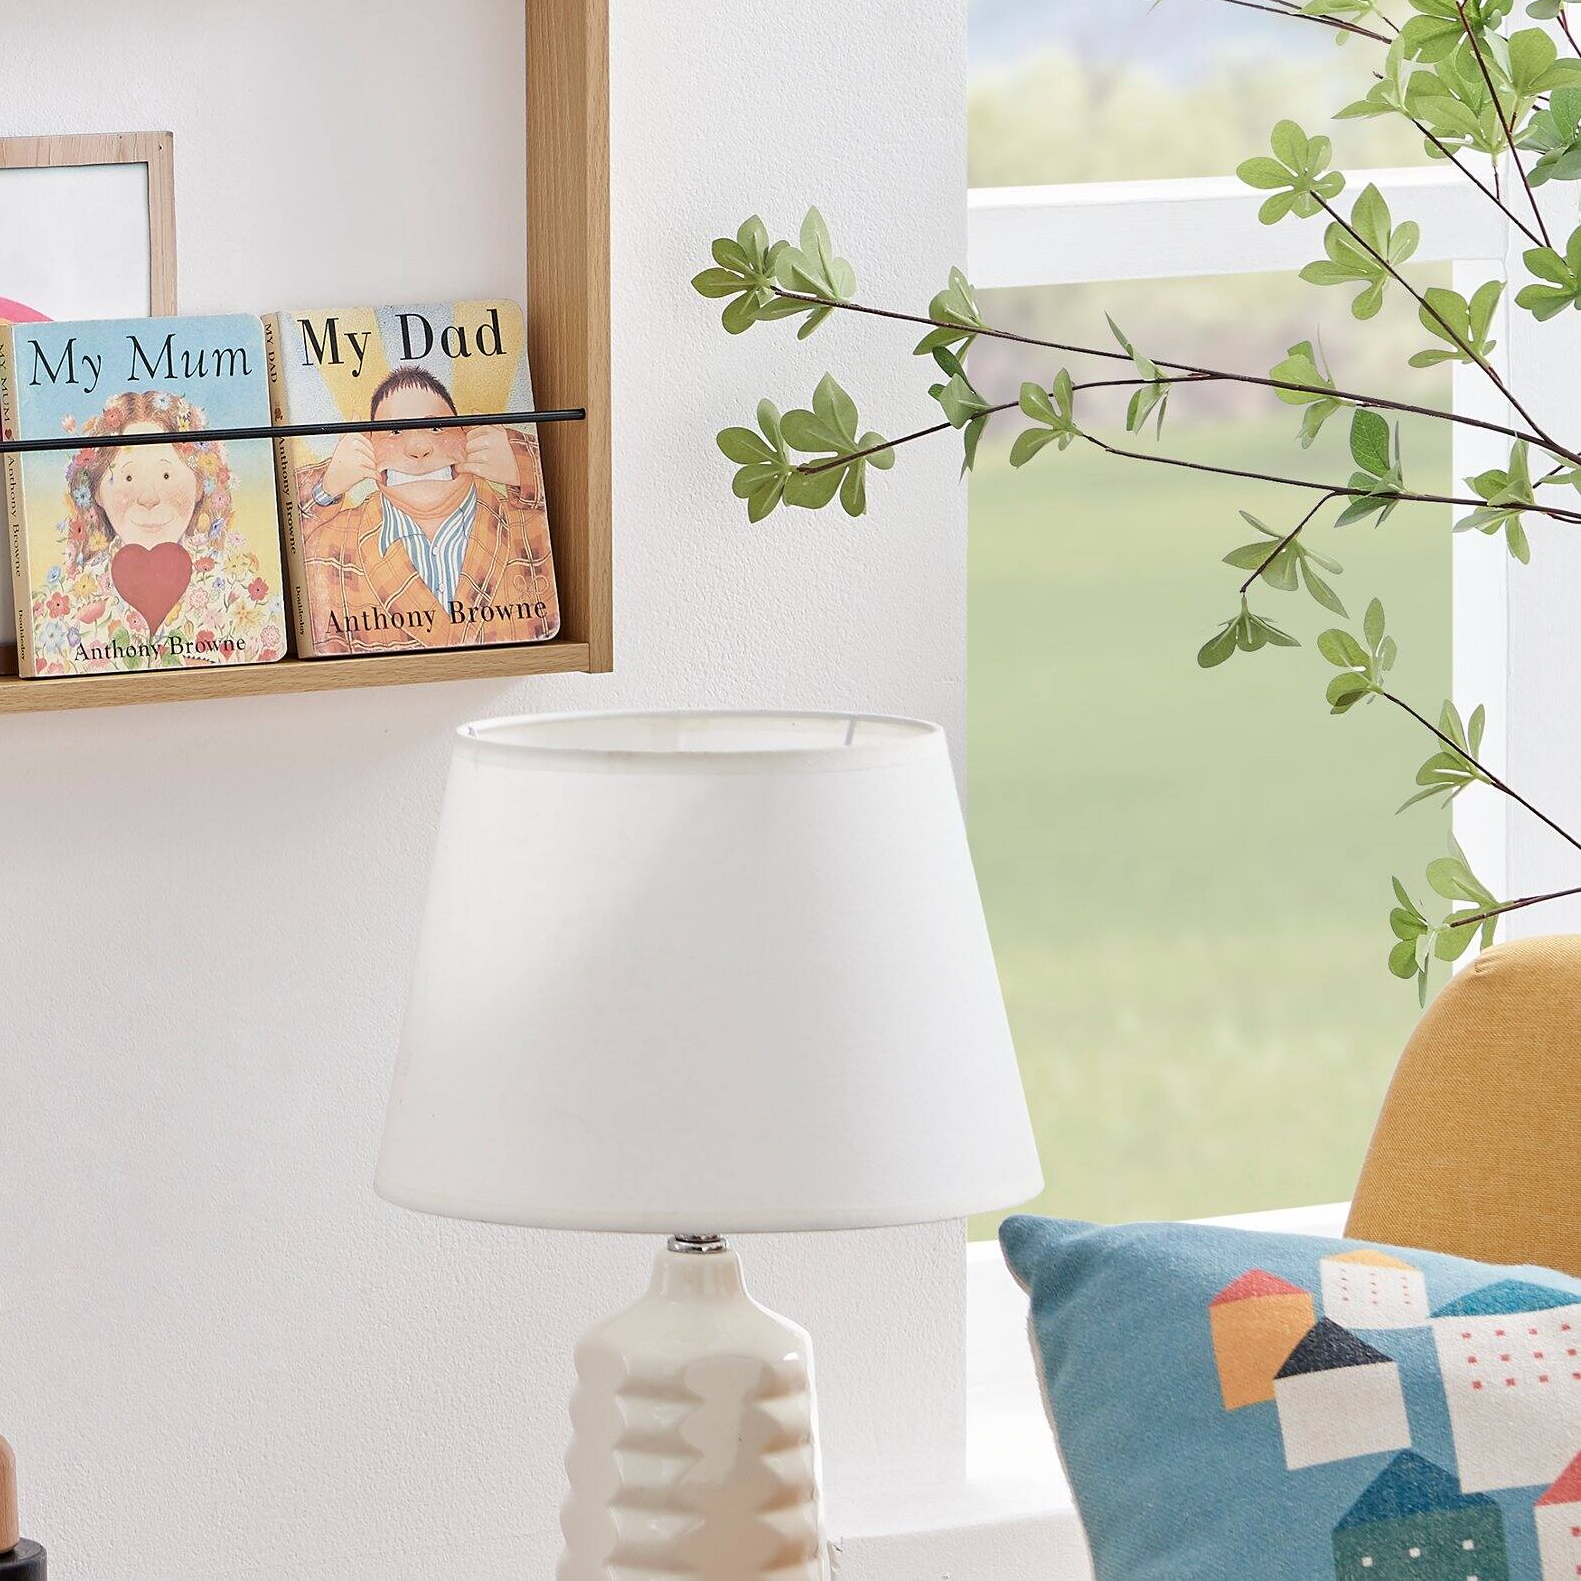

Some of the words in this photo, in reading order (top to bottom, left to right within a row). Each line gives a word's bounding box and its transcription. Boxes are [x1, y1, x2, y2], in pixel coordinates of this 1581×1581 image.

[265, 323, 274, 345] MY
[297, 317, 371, 377] My
[395, 308, 507, 362] Dad
[28, 337, 102, 394] My
[126, 333, 253, 382] Mum
[268, 349, 278, 384] DAD
[0, 377, 11, 423] MUM
[7, 455, 18, 518] Anthony
[277, 435, 291, 498] Anthony
[12, 523, 22, 577] Browne
[286, 500, 297, 555] Browne
[326, 607, 438, 635] Anthony
[448, 598, 547, 625] Browne
[74, 638, 163, 663] Anthony
[169, 635, 247, 656] Browne
